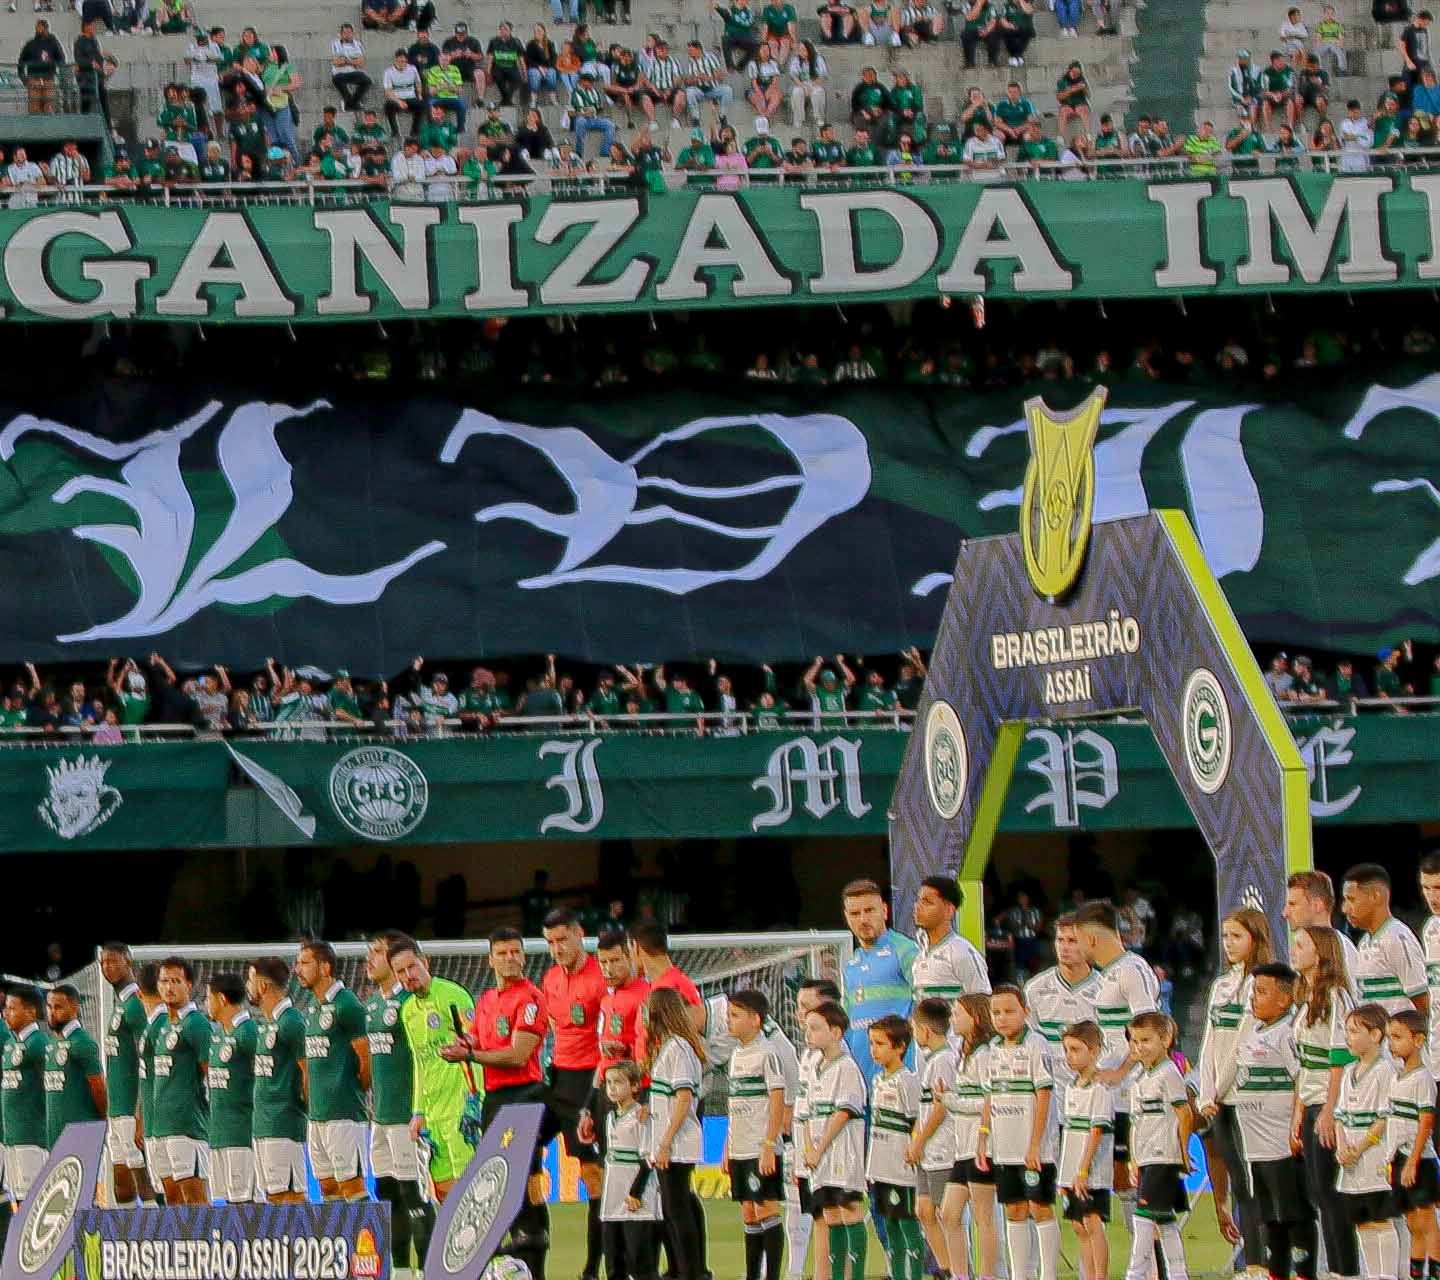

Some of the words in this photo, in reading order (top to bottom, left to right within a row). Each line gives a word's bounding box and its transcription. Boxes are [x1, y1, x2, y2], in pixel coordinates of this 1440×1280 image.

[992, 608, 1141, 669] BRASILEIRÃO
[102, 1228, 237, 1280] BRASILEIRÃO
[293, 1236, 349, 1280] 2023
